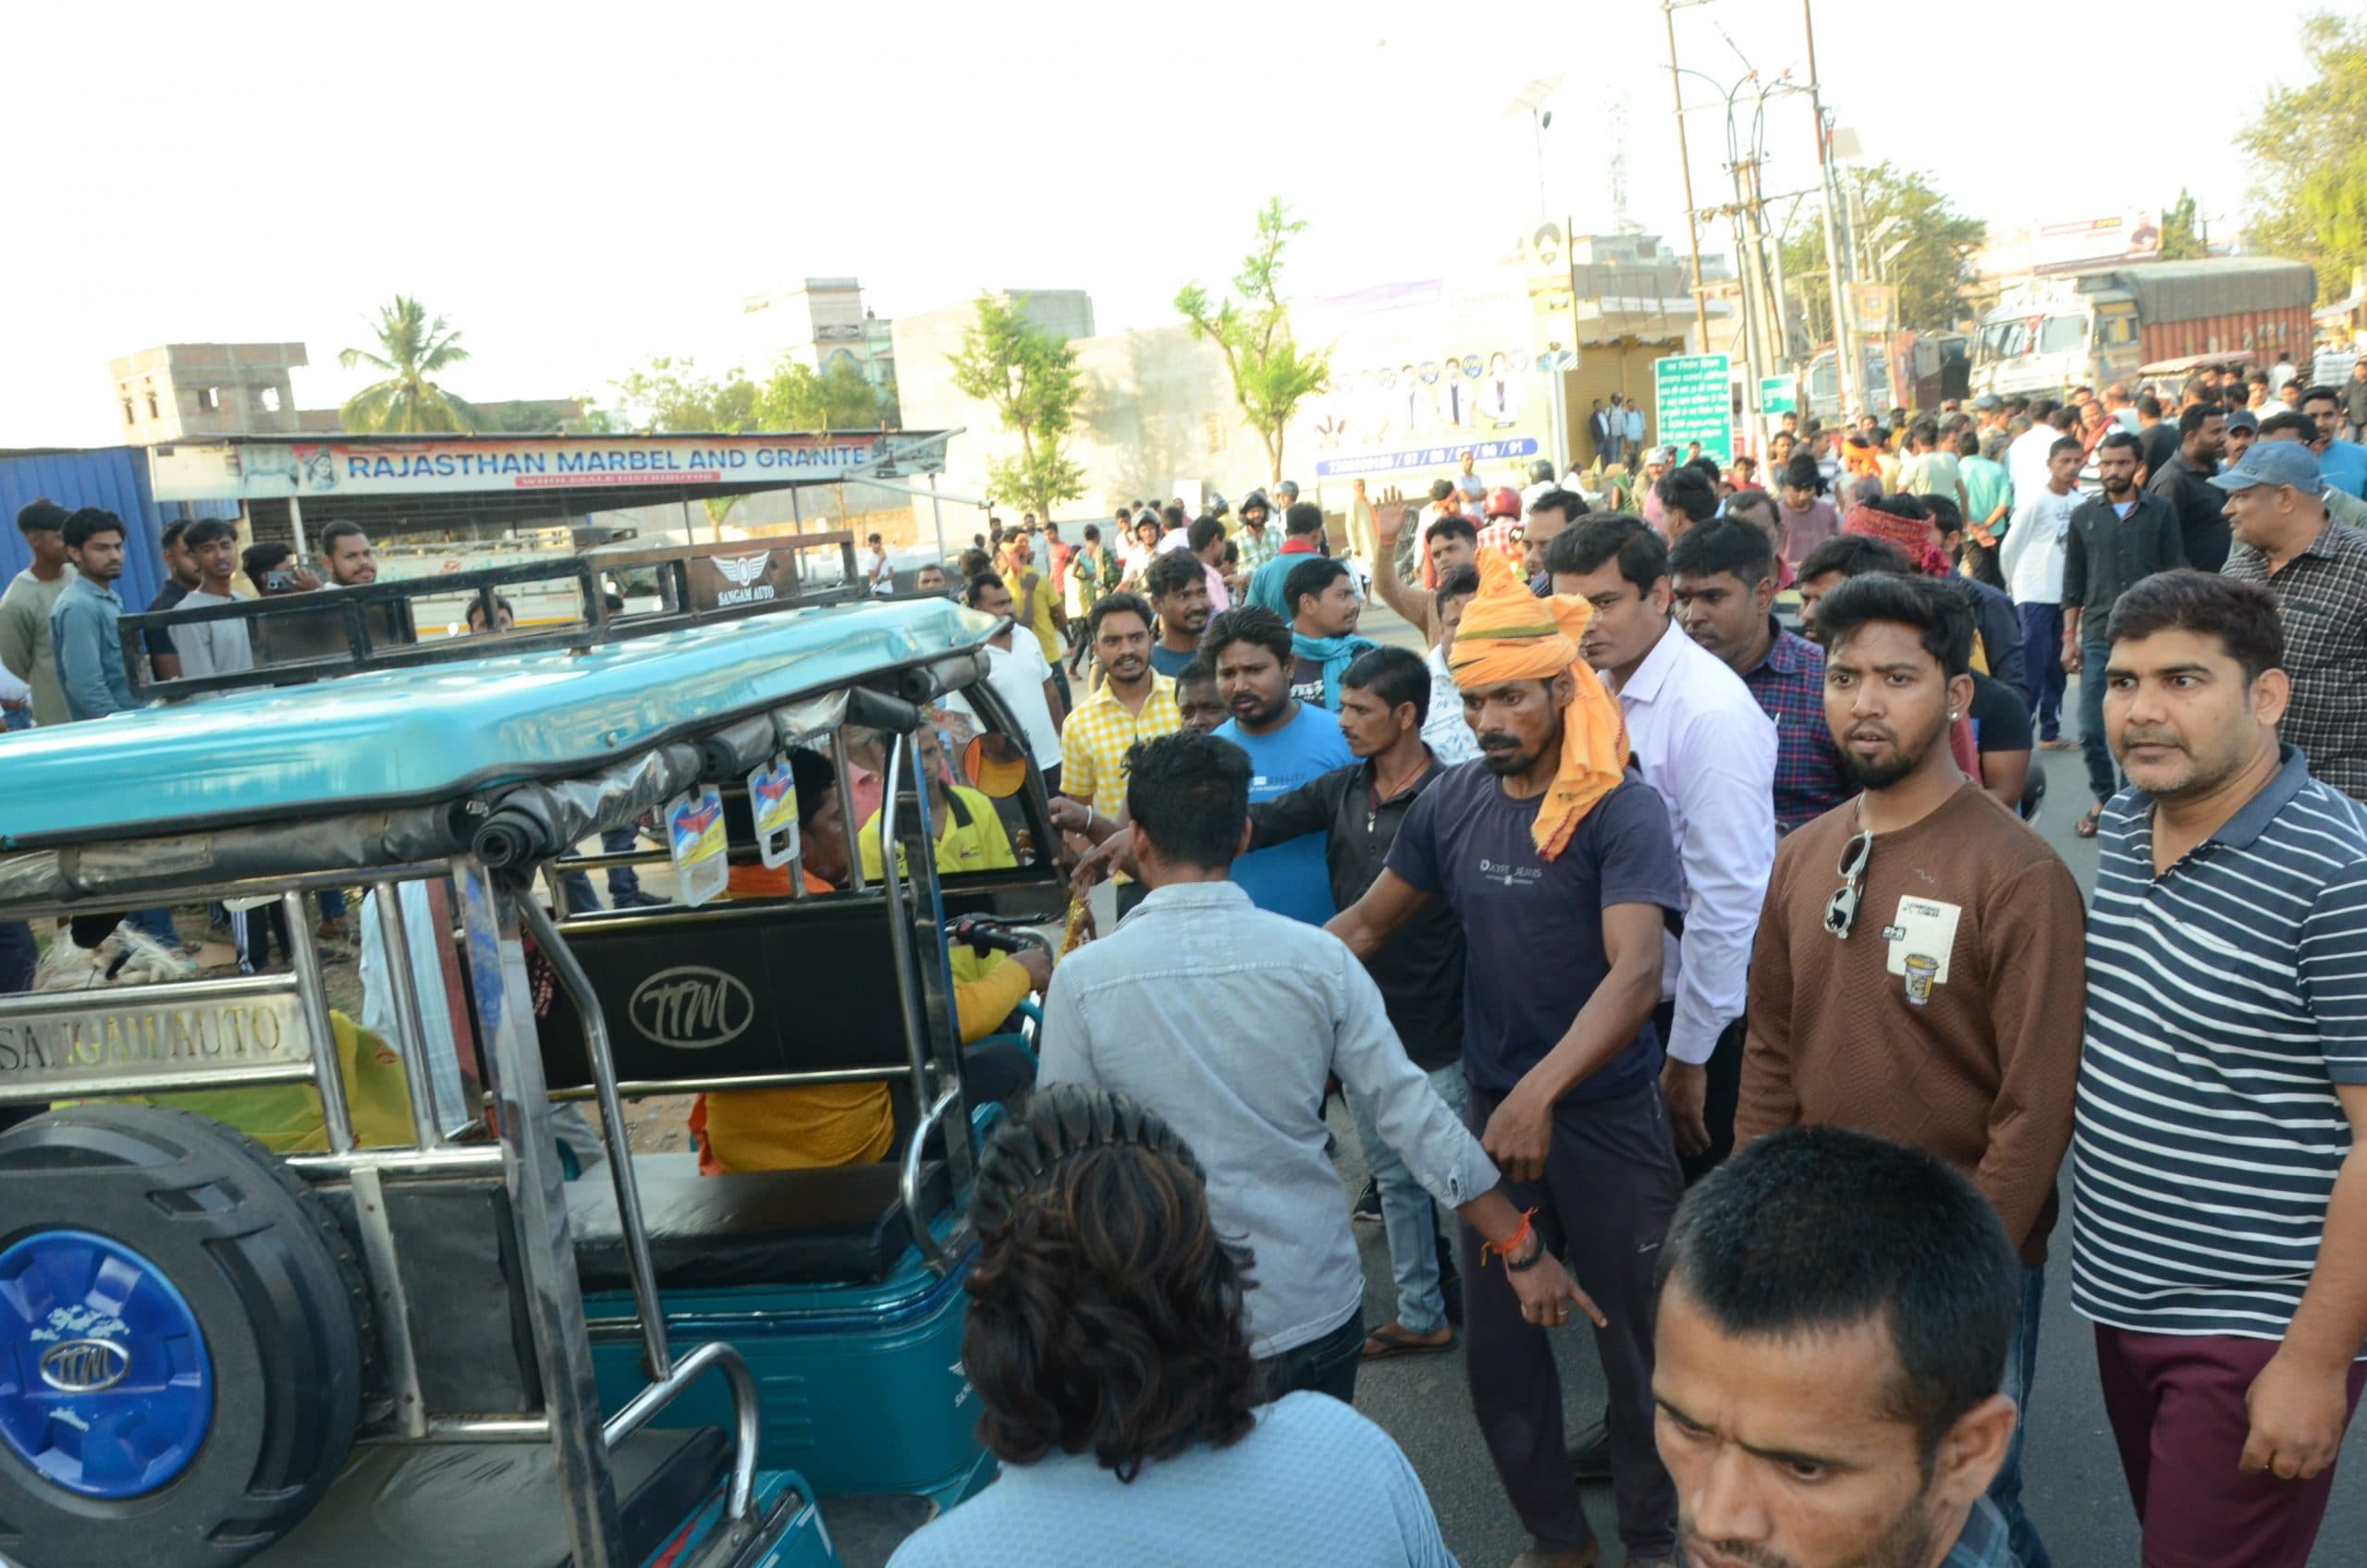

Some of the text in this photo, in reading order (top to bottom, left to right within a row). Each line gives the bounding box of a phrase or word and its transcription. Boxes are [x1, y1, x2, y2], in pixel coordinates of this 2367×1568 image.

[348, 446, 865, 478] RAJASTHAN MARBEL AND GRANITE
[521, 474, 614, 485] WHOLESALE
[717, 585, 775, 606] SANGAM AUTO
[172, 1006, 281, 1058] AUTO
